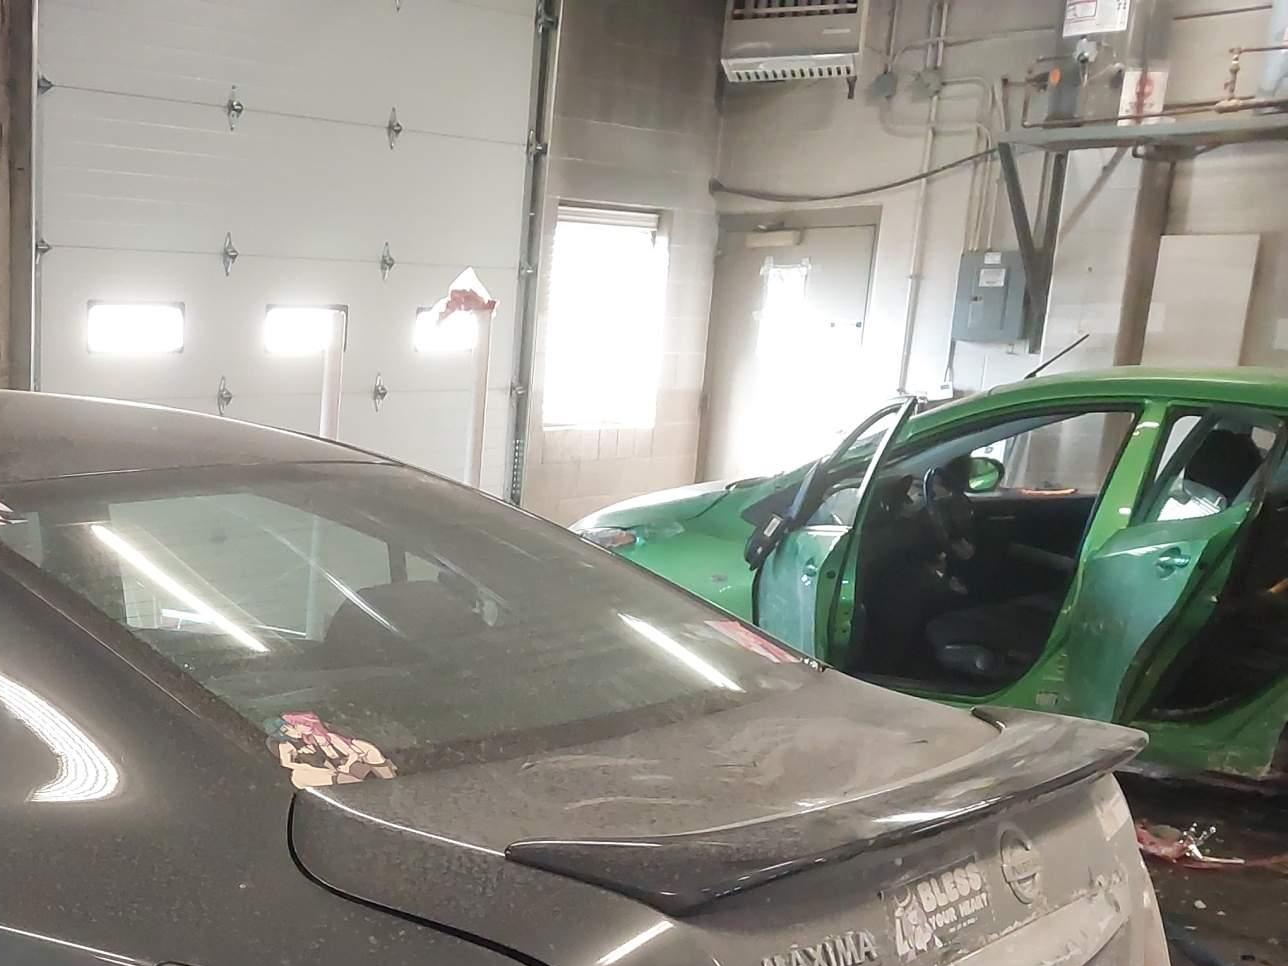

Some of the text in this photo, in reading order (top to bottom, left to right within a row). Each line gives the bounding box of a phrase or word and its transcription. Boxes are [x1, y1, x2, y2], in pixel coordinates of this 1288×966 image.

[916, 862, 982, 913] BLESS
[927, 906, 958, 930] YOUR
[958, 892, 989, 917] HEART
